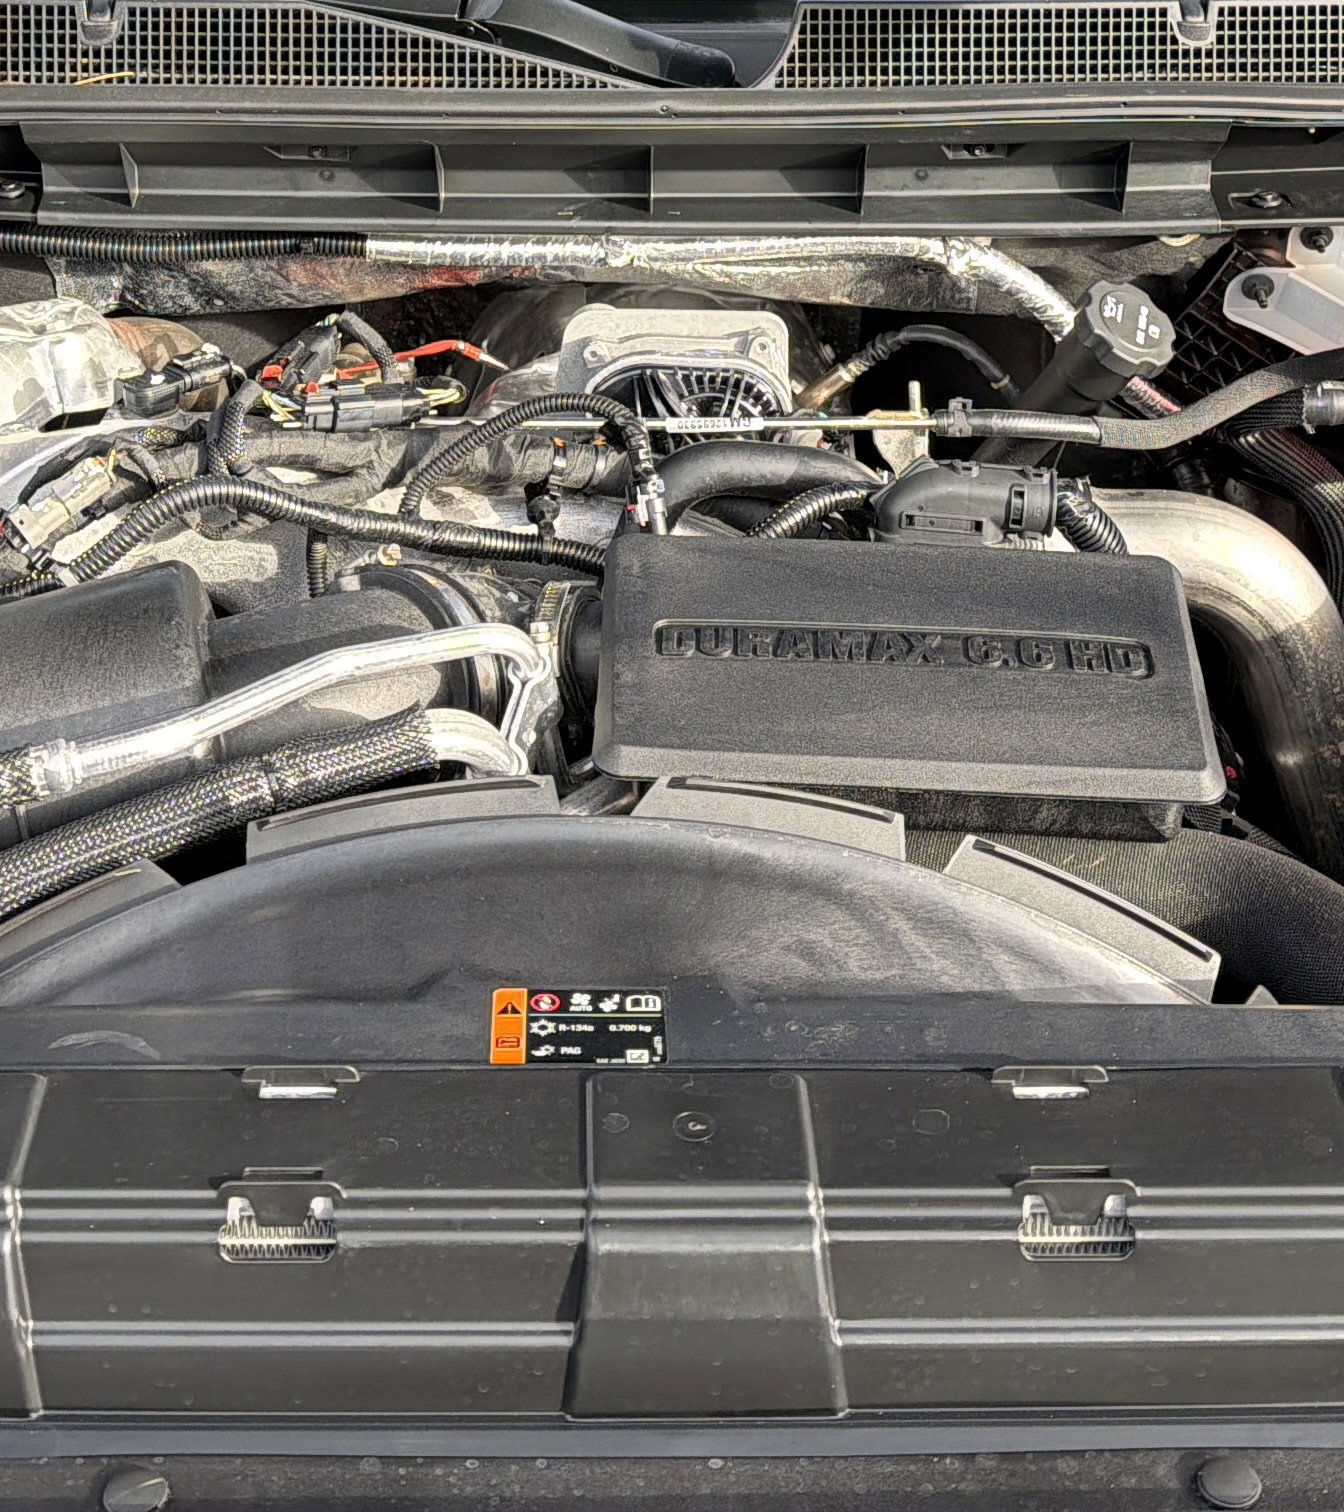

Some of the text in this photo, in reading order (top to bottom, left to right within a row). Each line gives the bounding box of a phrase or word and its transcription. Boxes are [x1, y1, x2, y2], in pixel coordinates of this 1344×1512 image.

[656, 624, 1149, 675] DURAMAX 6.6 HD
[560, 1046, 582, 1055] PAG
